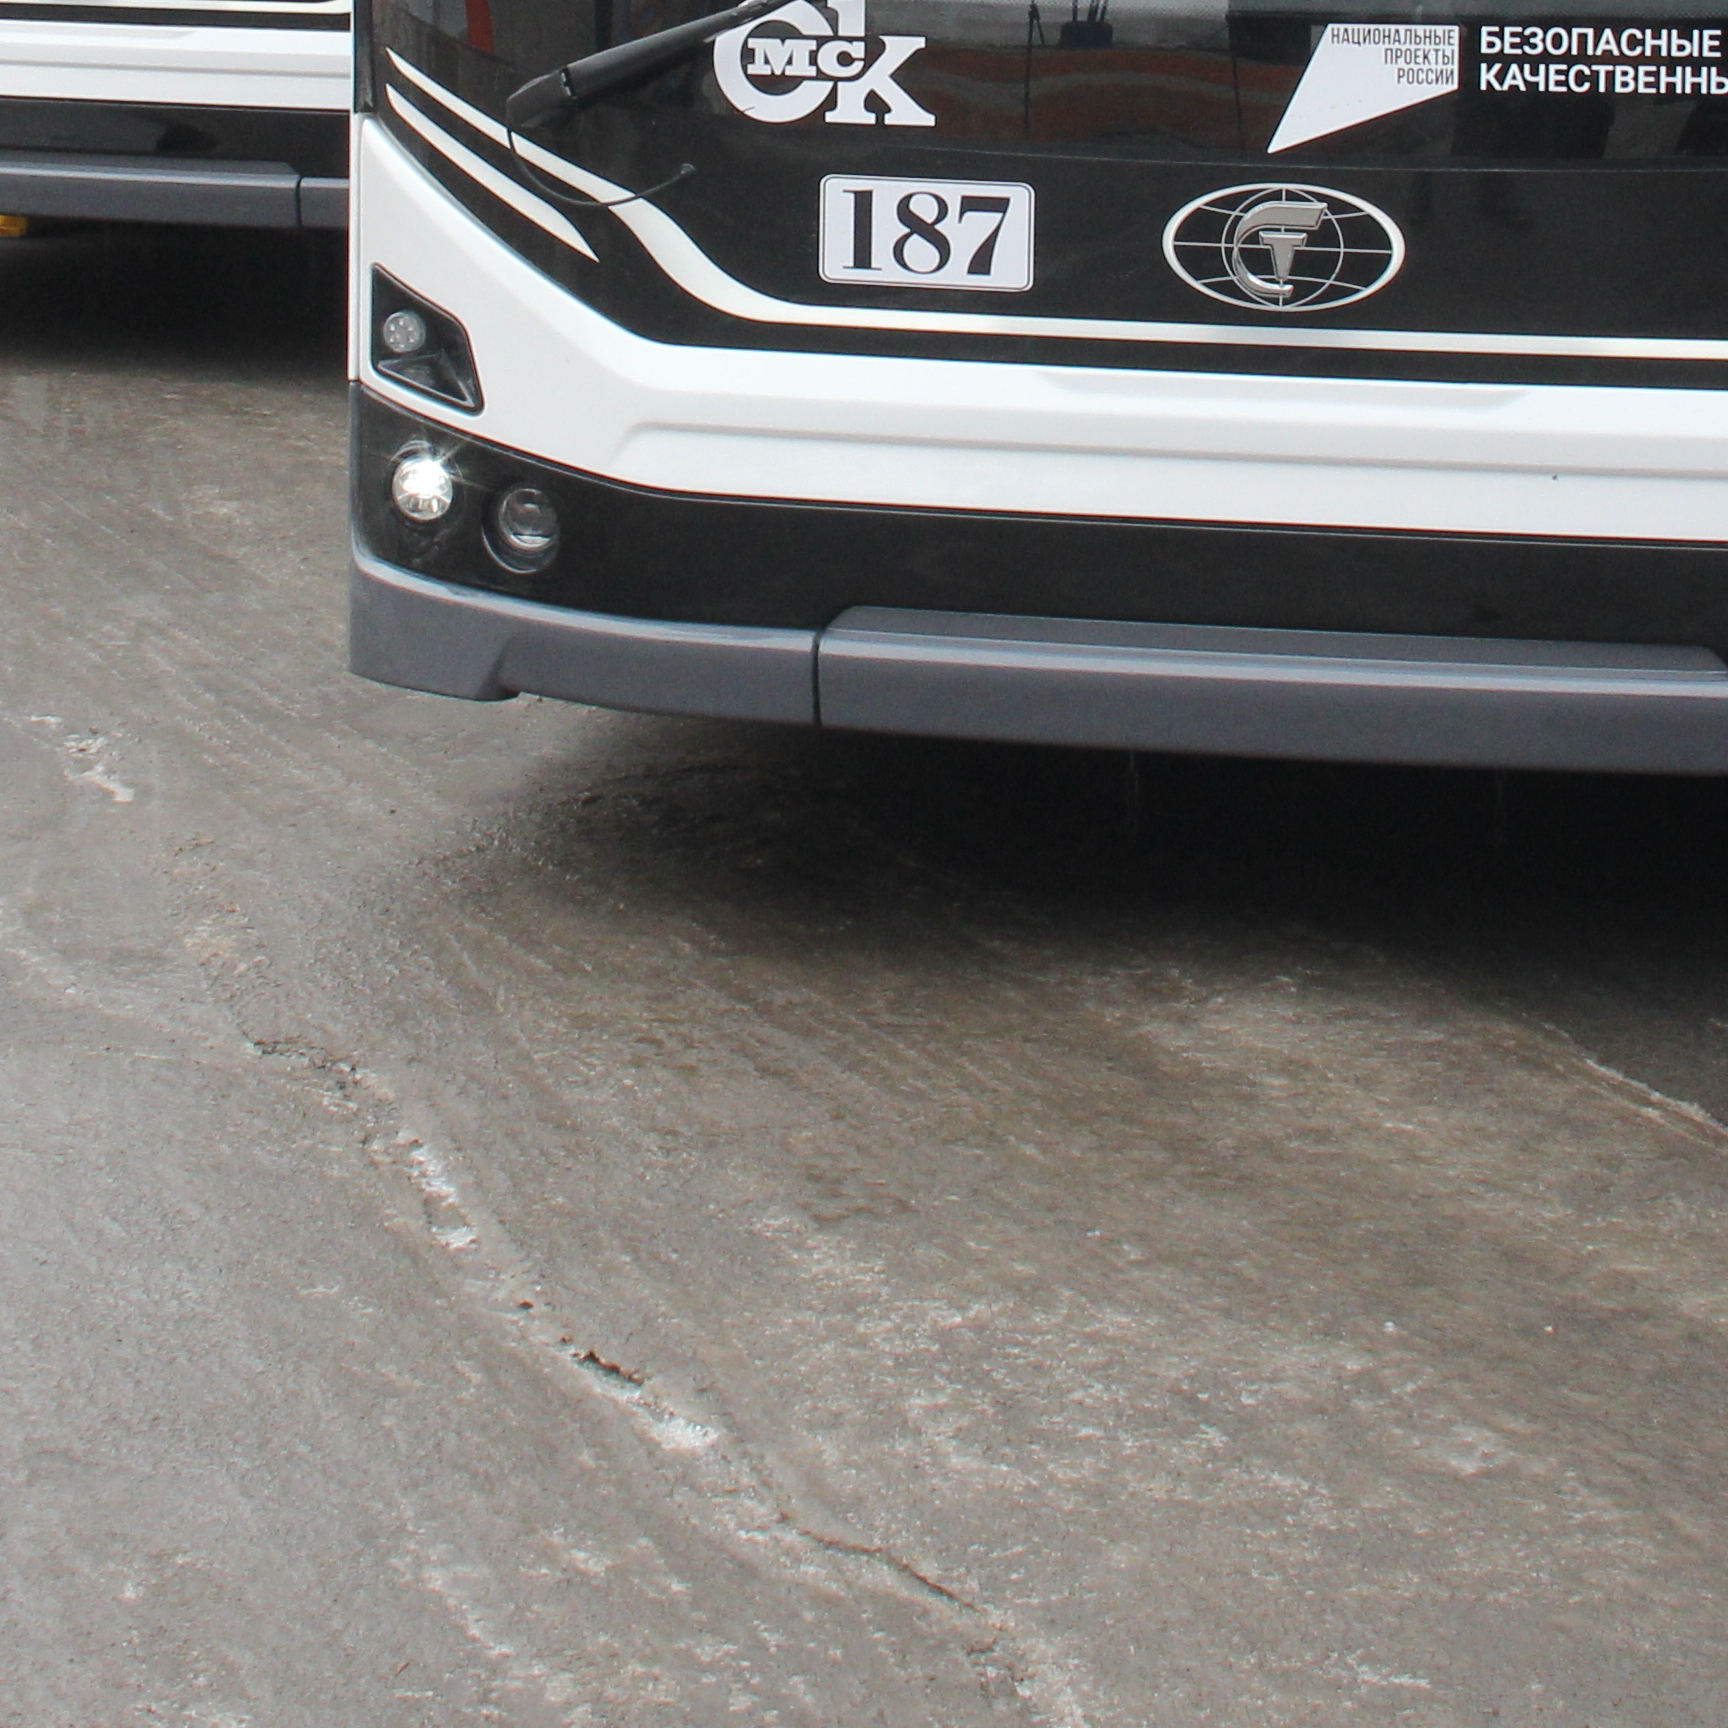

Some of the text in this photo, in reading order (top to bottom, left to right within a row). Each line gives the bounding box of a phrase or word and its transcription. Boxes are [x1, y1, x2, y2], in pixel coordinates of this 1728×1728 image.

[1330, 28, 1456, 47] НАЦИОНАЛЬНЫЕ
[1480, 25, 1722, 58] БЕЗОПАСНЫЕ
[1384, 48, 1455, 66] ПРОЕКТЫ
[1396, 68, 1455, 85] РОССИИ
[842, 188, 1011, 276] 187
